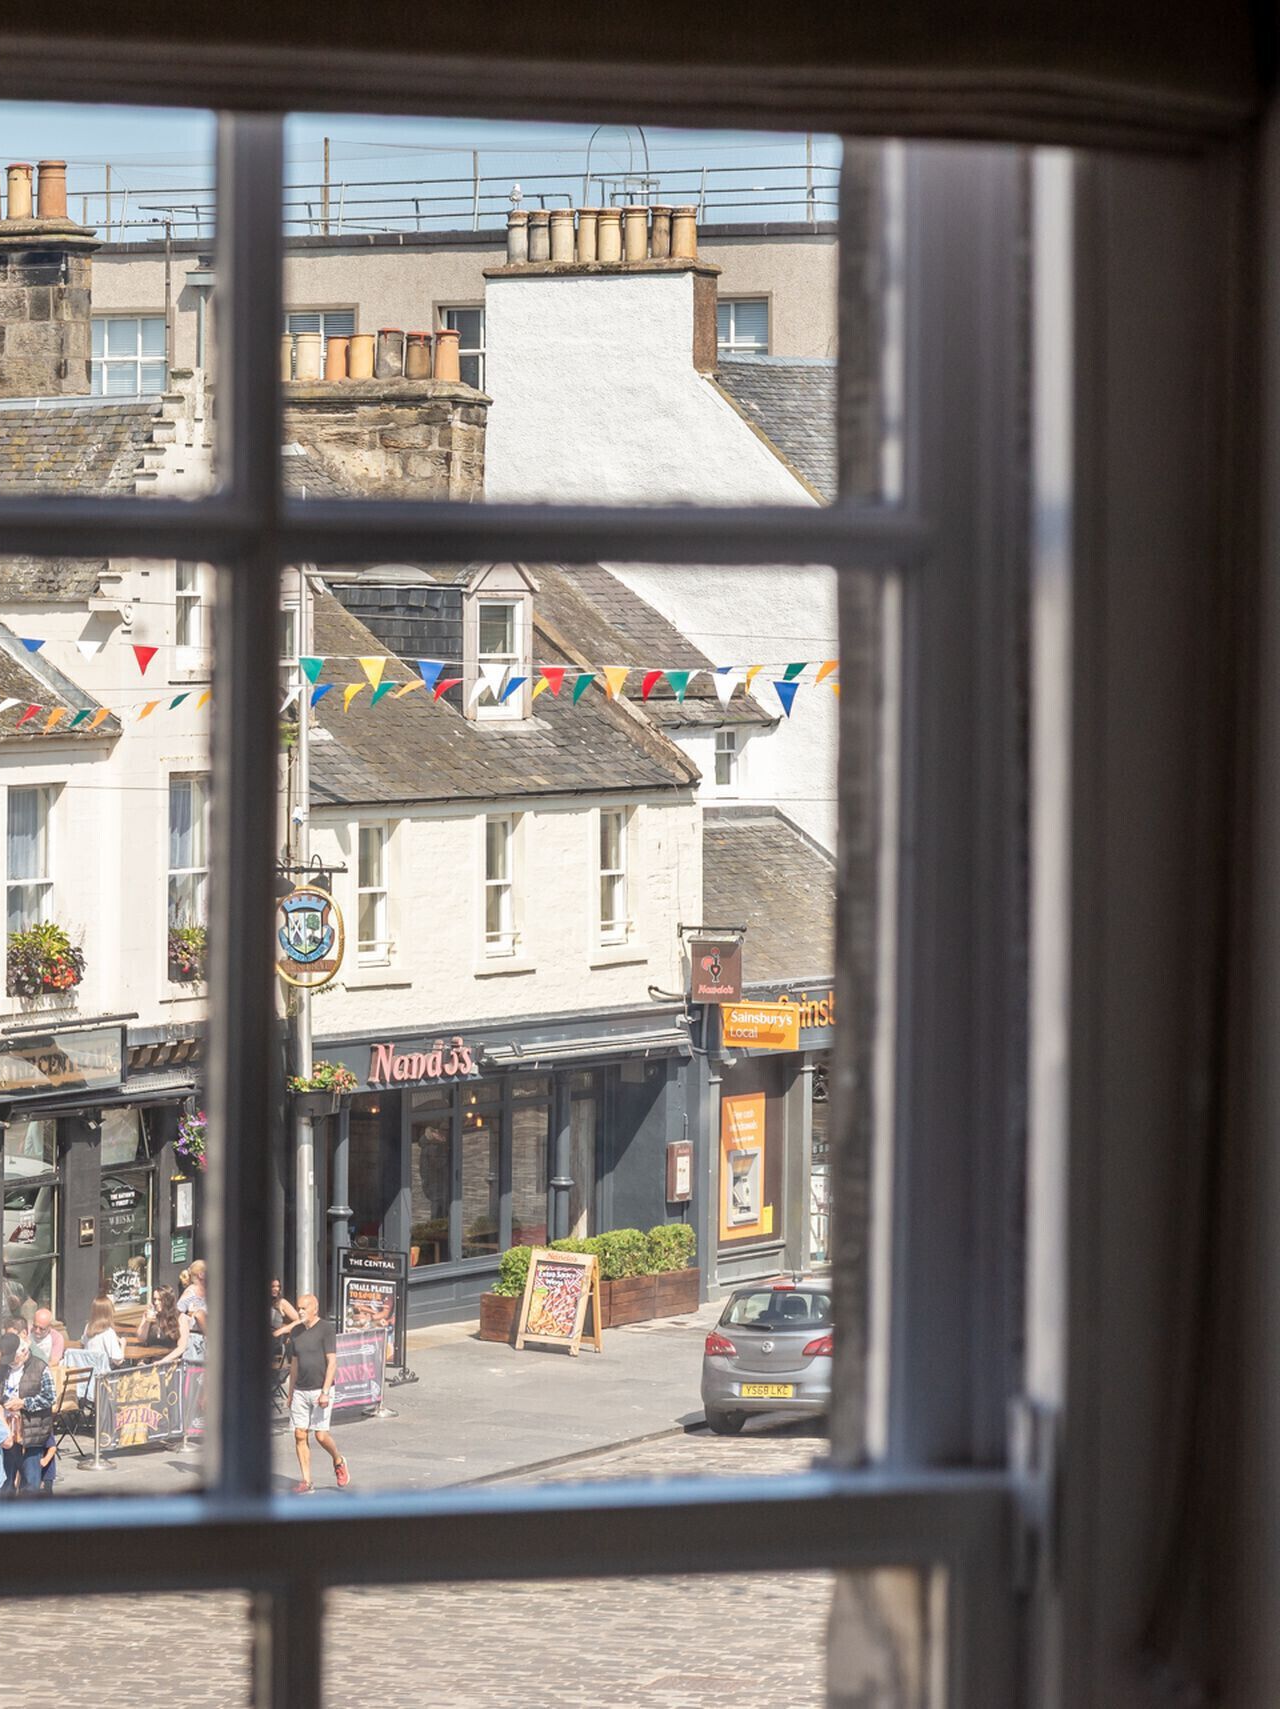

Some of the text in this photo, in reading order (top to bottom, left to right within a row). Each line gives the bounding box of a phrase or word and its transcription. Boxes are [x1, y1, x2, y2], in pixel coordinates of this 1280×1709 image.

[698, 985, 734, 994] Nando's
[731, 1010, 793, 1028] Sainsbury's
[730, 1026, 759, 1039] Local
[349, 1258, 396, 1270] THE CENTRAL
[348, 1283, 394, 1295] SMALL PLATES
